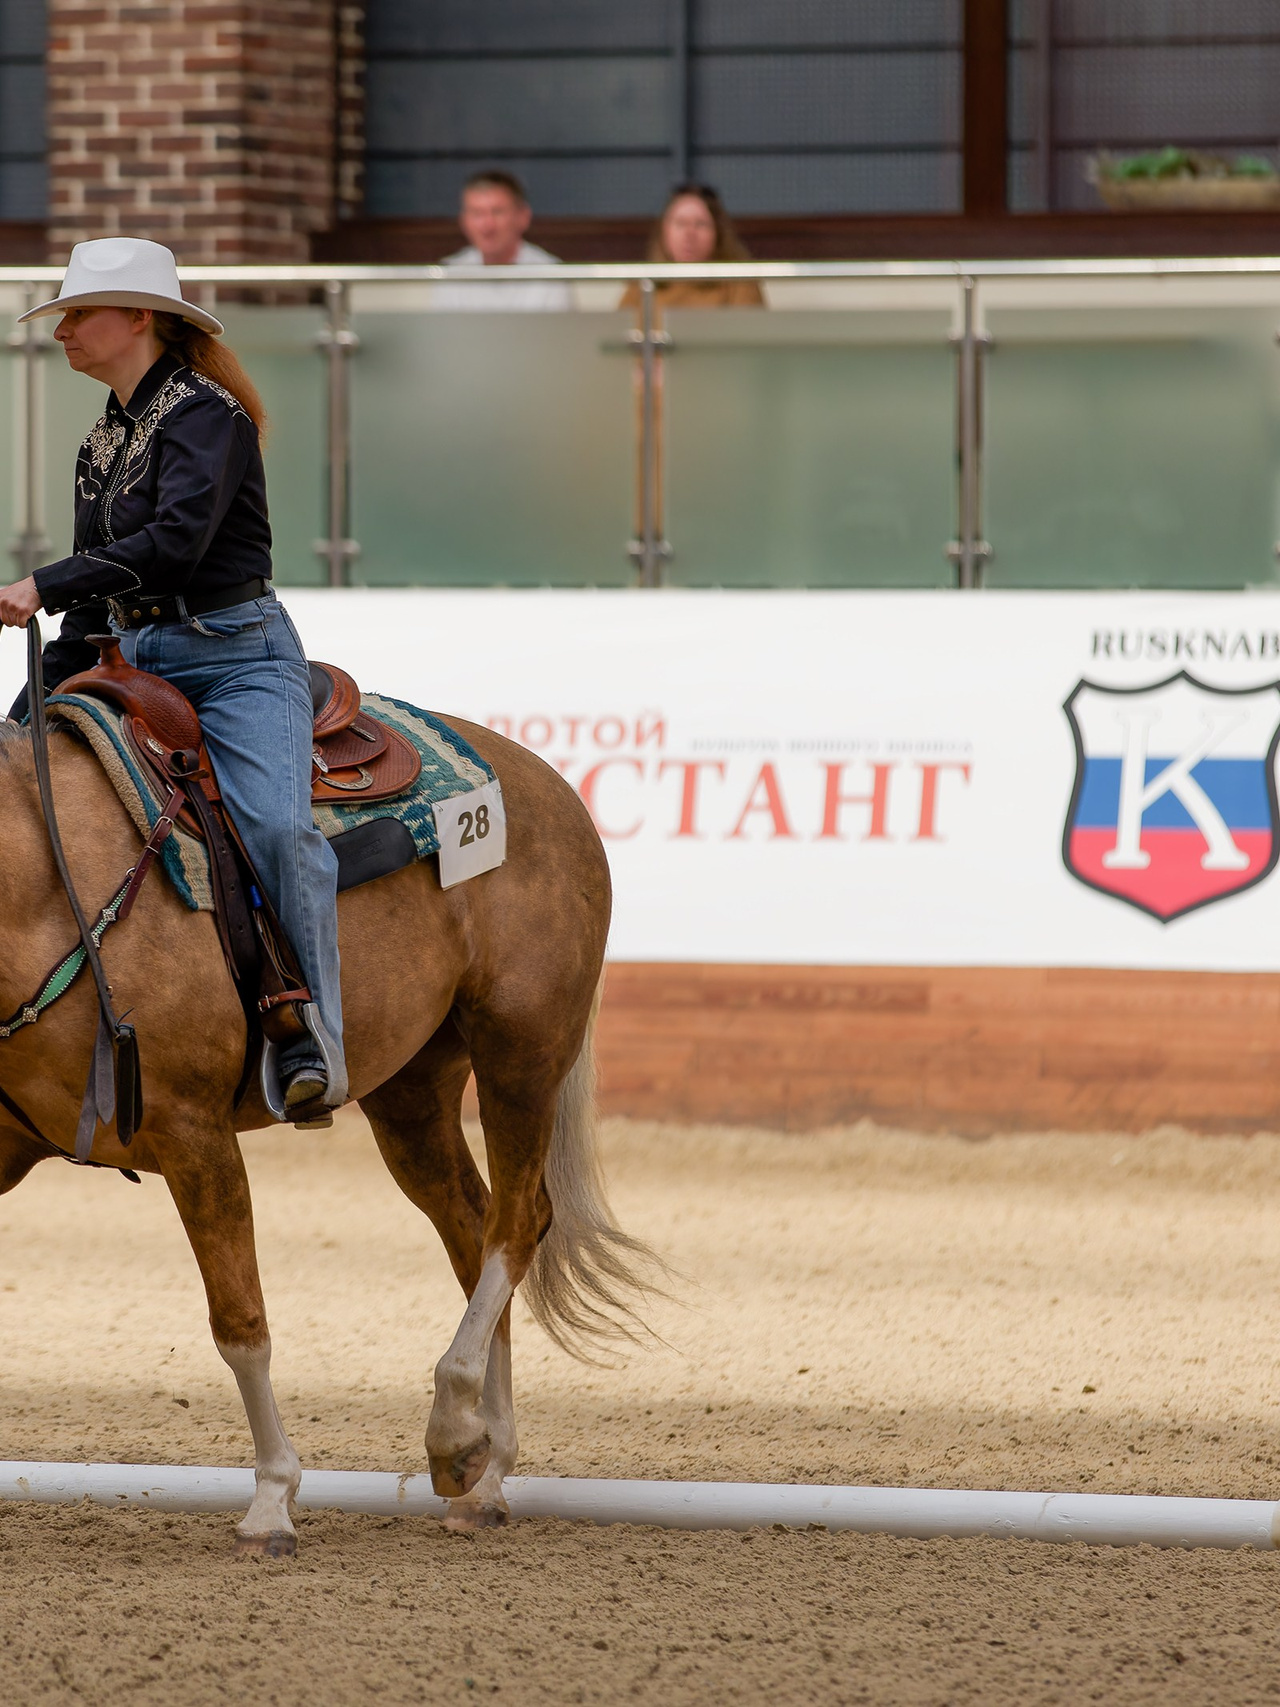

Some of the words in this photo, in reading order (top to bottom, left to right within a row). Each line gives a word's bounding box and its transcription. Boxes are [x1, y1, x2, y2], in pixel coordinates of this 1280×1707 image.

[486, 707, 668, 749] ЛОТОЙ
[560, 755, 975, 843] СТАНГ
[457, 804, 490, 847] 28
